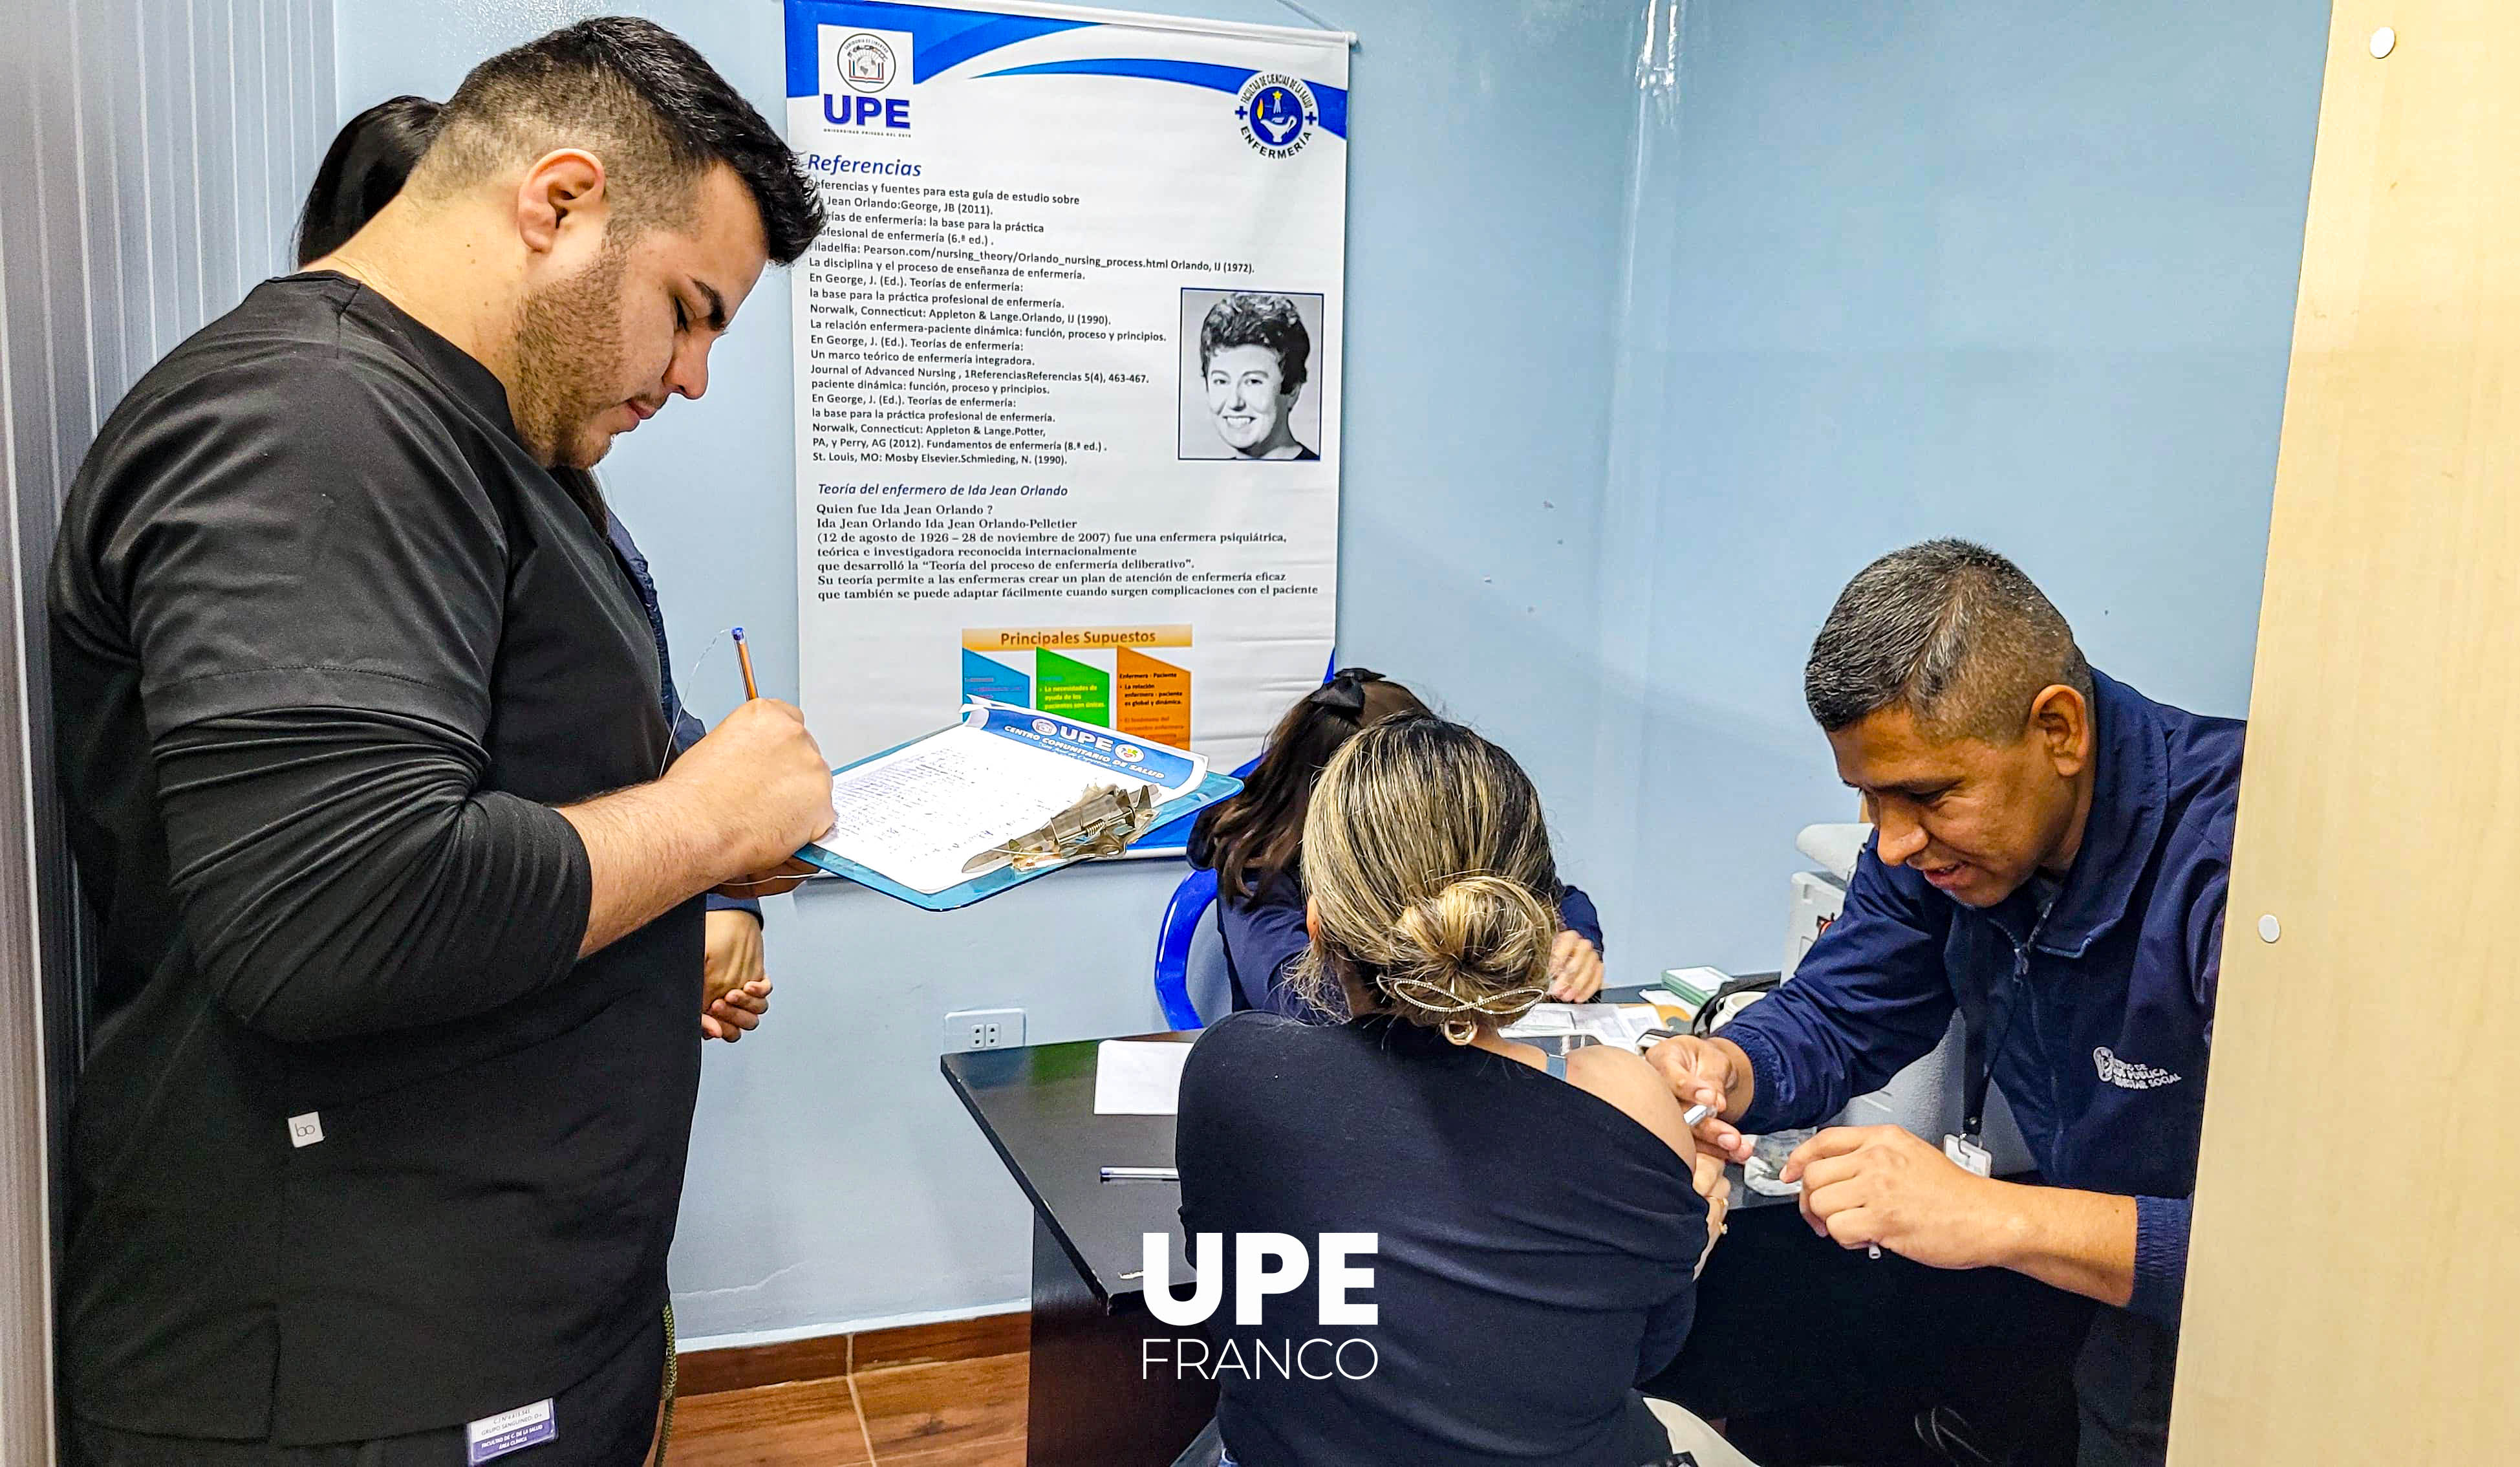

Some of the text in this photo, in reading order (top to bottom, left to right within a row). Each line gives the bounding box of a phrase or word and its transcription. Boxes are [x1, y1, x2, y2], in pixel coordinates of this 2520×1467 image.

[1240, 80, 1260, 103] FACULTAD
[1267, 74, 1290, 86] CIENCIAS
[823, 93, 911, 129] UPE
[808, 153, 922, 177] Referencias
[871, 184, 878, 195] y
[880, 182, 920, 195] fuentes
[923, 188, 946, 197] para
[949, 189, 970, 199] esta
[972, 189, 994, 201] guía
[996, 190, 1009, 201] de
[1012, 192, 1050, 203] estudio
[1051, 194, 1080, 205] sobre
[826, 195, 851, 207] Jean
[943, 202, 955, 213] JB
[958, 202, 993, 217] (2011).
[809, 241, 861, 255] iladelfia:
[1171, 260, 1212, 273] Orlando,
[1223, 261, 1255, 276] (1972).
[810, 303, 858, 316] Norwalk,
[861, 305, 926, 318] Connecticut:
[929, 309, 976, 321] Appleton
[978, 310, 987, 320] &
[989, 310, 1065, 325] Lange.Orlando,
[1077, 314, 1111, 327] (1990).
[810, 318, 1167, 343] La relación enfermera-paciente dinámica: función, proceso y principios.
[810, 364, 1149, 384] Journal of Advanced Nursing 1ReferenciasReferencias 5(4), 463-467.
[812, 451, 1068, 466] St. Louis, MO: Mosby Elsevier.Schmieding, N. (1990).
[818, 483, 1068, 497] Teoría del enfermero de Ida Jean Orlando
[816, 503, 854, 516] Quien
[857, 503, 877, 514] fue
[881, 503, 900, 514] Ida
[903, 504, 932, 516] Jean
[936, 504, 984, 515] Orlando
[817, 517, 1078, 530] Ida Jean Orlando Ida Jean Orlando-Pelletier
[817, 532, 837, 545] (12
[841, 532, 856, 543] de
[859, 534, 898, 545] agosto
[901, 532, 916, 543] de
[920, 532, 949, 543] 1926
[962, 532, 976, 543] 28
[980, 532, 994, 543] de
[997, 532, 1058, 543] noviembre
[1061, 532, 1075, 543] de
[1077, 532, 1111, 545] 2007)
[1114, 532, 1132, 543] fue
[1136, 534, 1156, 543] una
[1159, 532, 1216, 542] enfermera
[1220, 532, 1287, 545] psiquiátrica,
[817, 545, 1137, 560] teórica e investigadora reconocida internacionalmente
[817, 563, 840, 574] que
[843, 560, 905, 571] desarrolló
[908, 560, 919, 570] la
[969, 560, 987, 570] del
[991, 563, 1035, 573] proceso
[1038, 559, 1052, 570] de
[1055, 559, 1118, 570] enfermería
[1000, 631, 1156, 647] Principales Supuestos
[1059, 724, 1114, 753] UPE
[1004, 725, 1041, 741] CENTRO
[1042, 734, 1111, 763] COMUNITARIO
[1112, 759, 1128, 768] DE
[1128, 764, 1165, 779] SALUD
